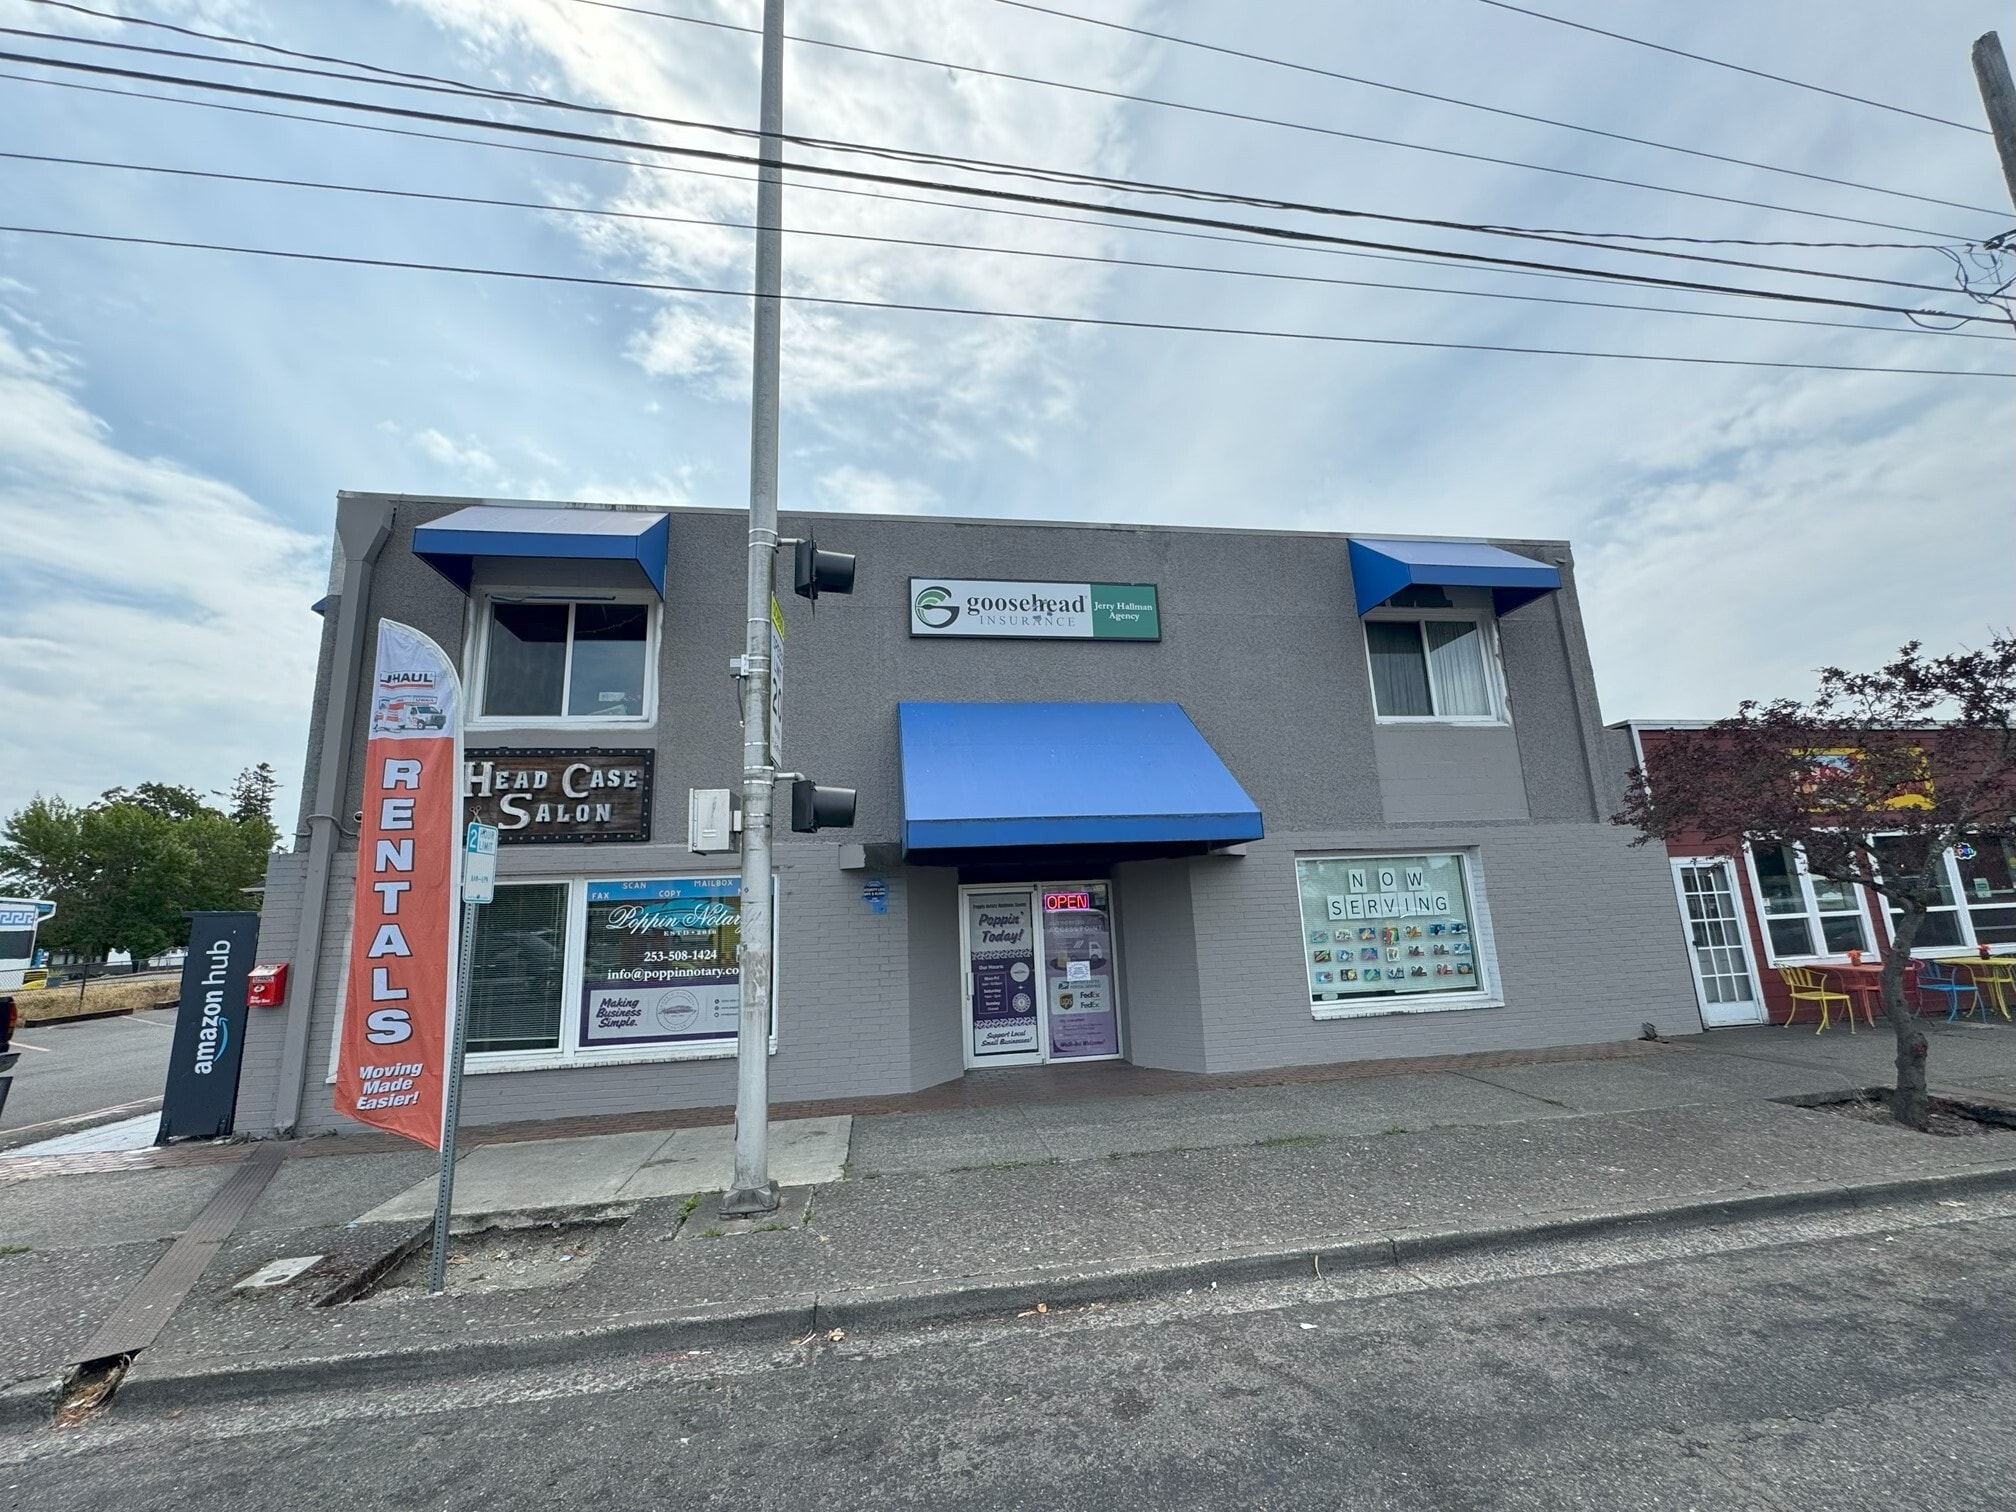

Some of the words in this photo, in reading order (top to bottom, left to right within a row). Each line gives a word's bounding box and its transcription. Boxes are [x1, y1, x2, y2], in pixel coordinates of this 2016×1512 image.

[967, 593, 1086, 616] goosehead
[1094, 601, 1116, 612] Jerry
[1117, 602, 1153, 611] Hallman
[980, 615, 1076, 627] INSURANCE
[1109, 611, 1141, 622] Agency
[464, 761, 548, 798] HEAD
[562, 763, 638, 799] CASE
[498, 793, 612, 830] SALON
[469, 828, 478, 848] 2
[622, 881, 647, 890] SCAN
[694, 879, 733, 887] MAILBOX
[1352, 872, 1422, 887] NOW
[591, 891, 610, 900] FAX
[658, 889, 682, 897] COPY
[366, 758, 423, 1045] RENTALS
[1047, 895, 1087, 909] OPEN
[1331, 896, 1447, 915] SERVING
[606, 904, 680, 935] Poppin
[982, 928, 1024, 944] Today!
[201, 940, 231, 985] hub
[644, 949, 718, 962] 253-508-1424
[607, 967, 739, 982] info@poppinnotary.co
[600, 997, 640, 1009] Making
[596, 1007, 642, 1019] Business
[598, 1016, 638, 1029] Simple.
[194, 990, 224, 1075] amazon
[360, 1062, 423, 1080] Moving
[363, 1077, 413, 1094] Made
[356, 1091, 420, 1110] Easier!
